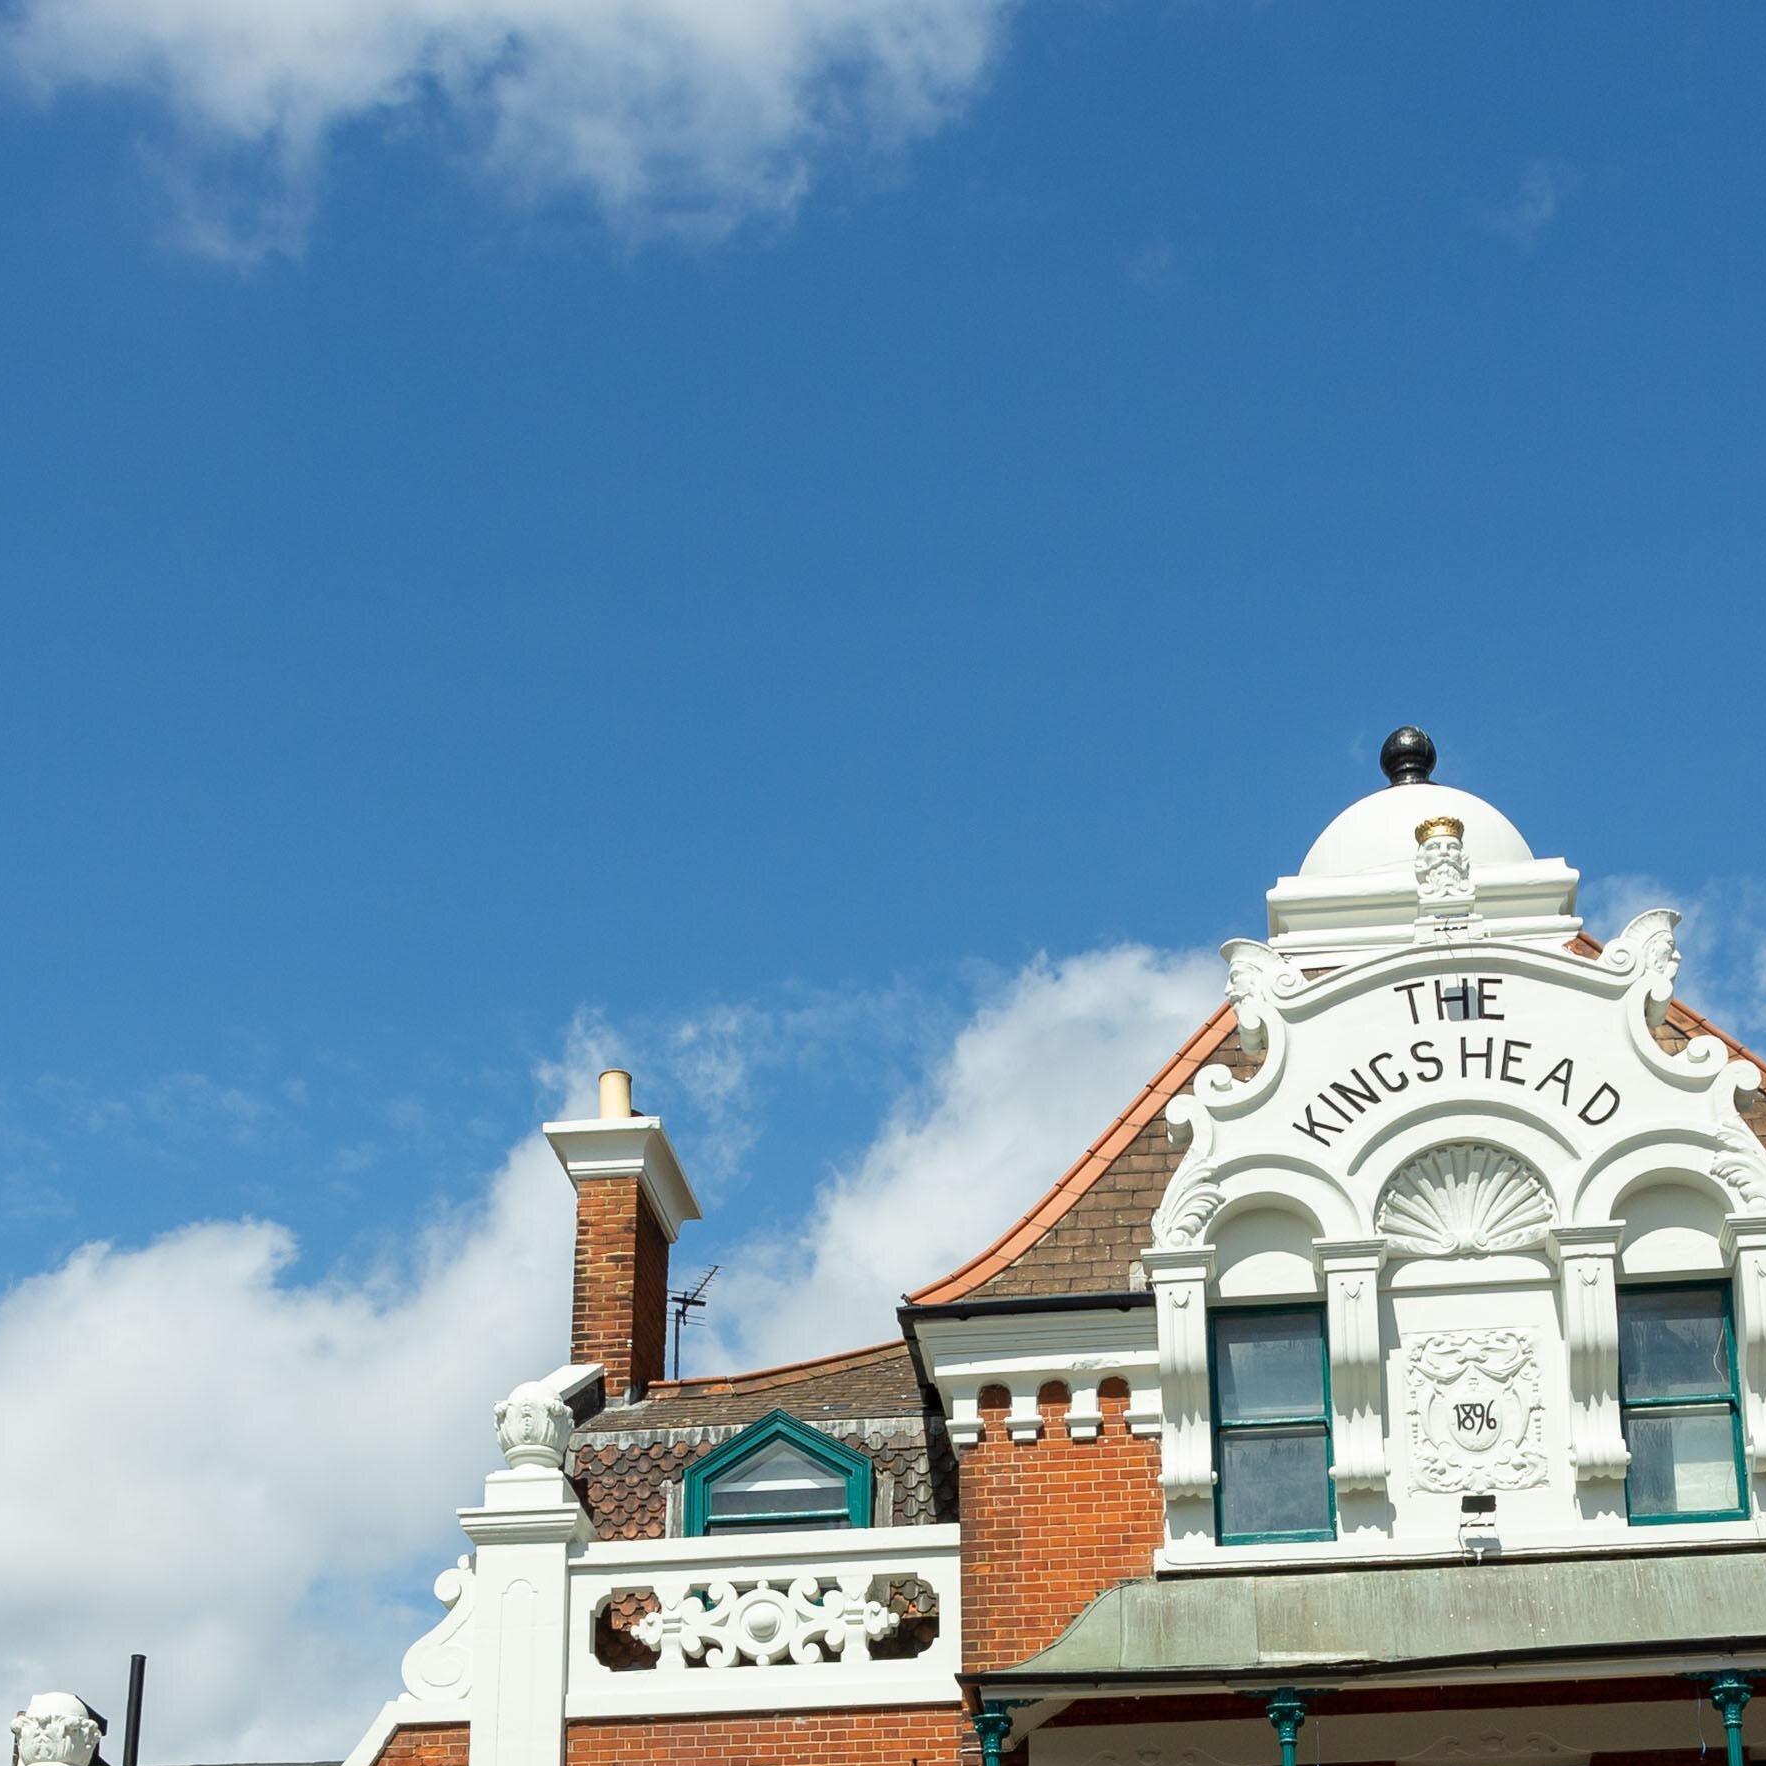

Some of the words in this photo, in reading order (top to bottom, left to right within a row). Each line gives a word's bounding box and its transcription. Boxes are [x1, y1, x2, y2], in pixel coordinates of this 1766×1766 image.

[1393, 977, 1505, 1025] THE
[1291, 1037, 1444, 1148] KINGS
[1459, 1036, 1622, 1127] HEAD
[1452, 1399, 1498, 1436] 1896
